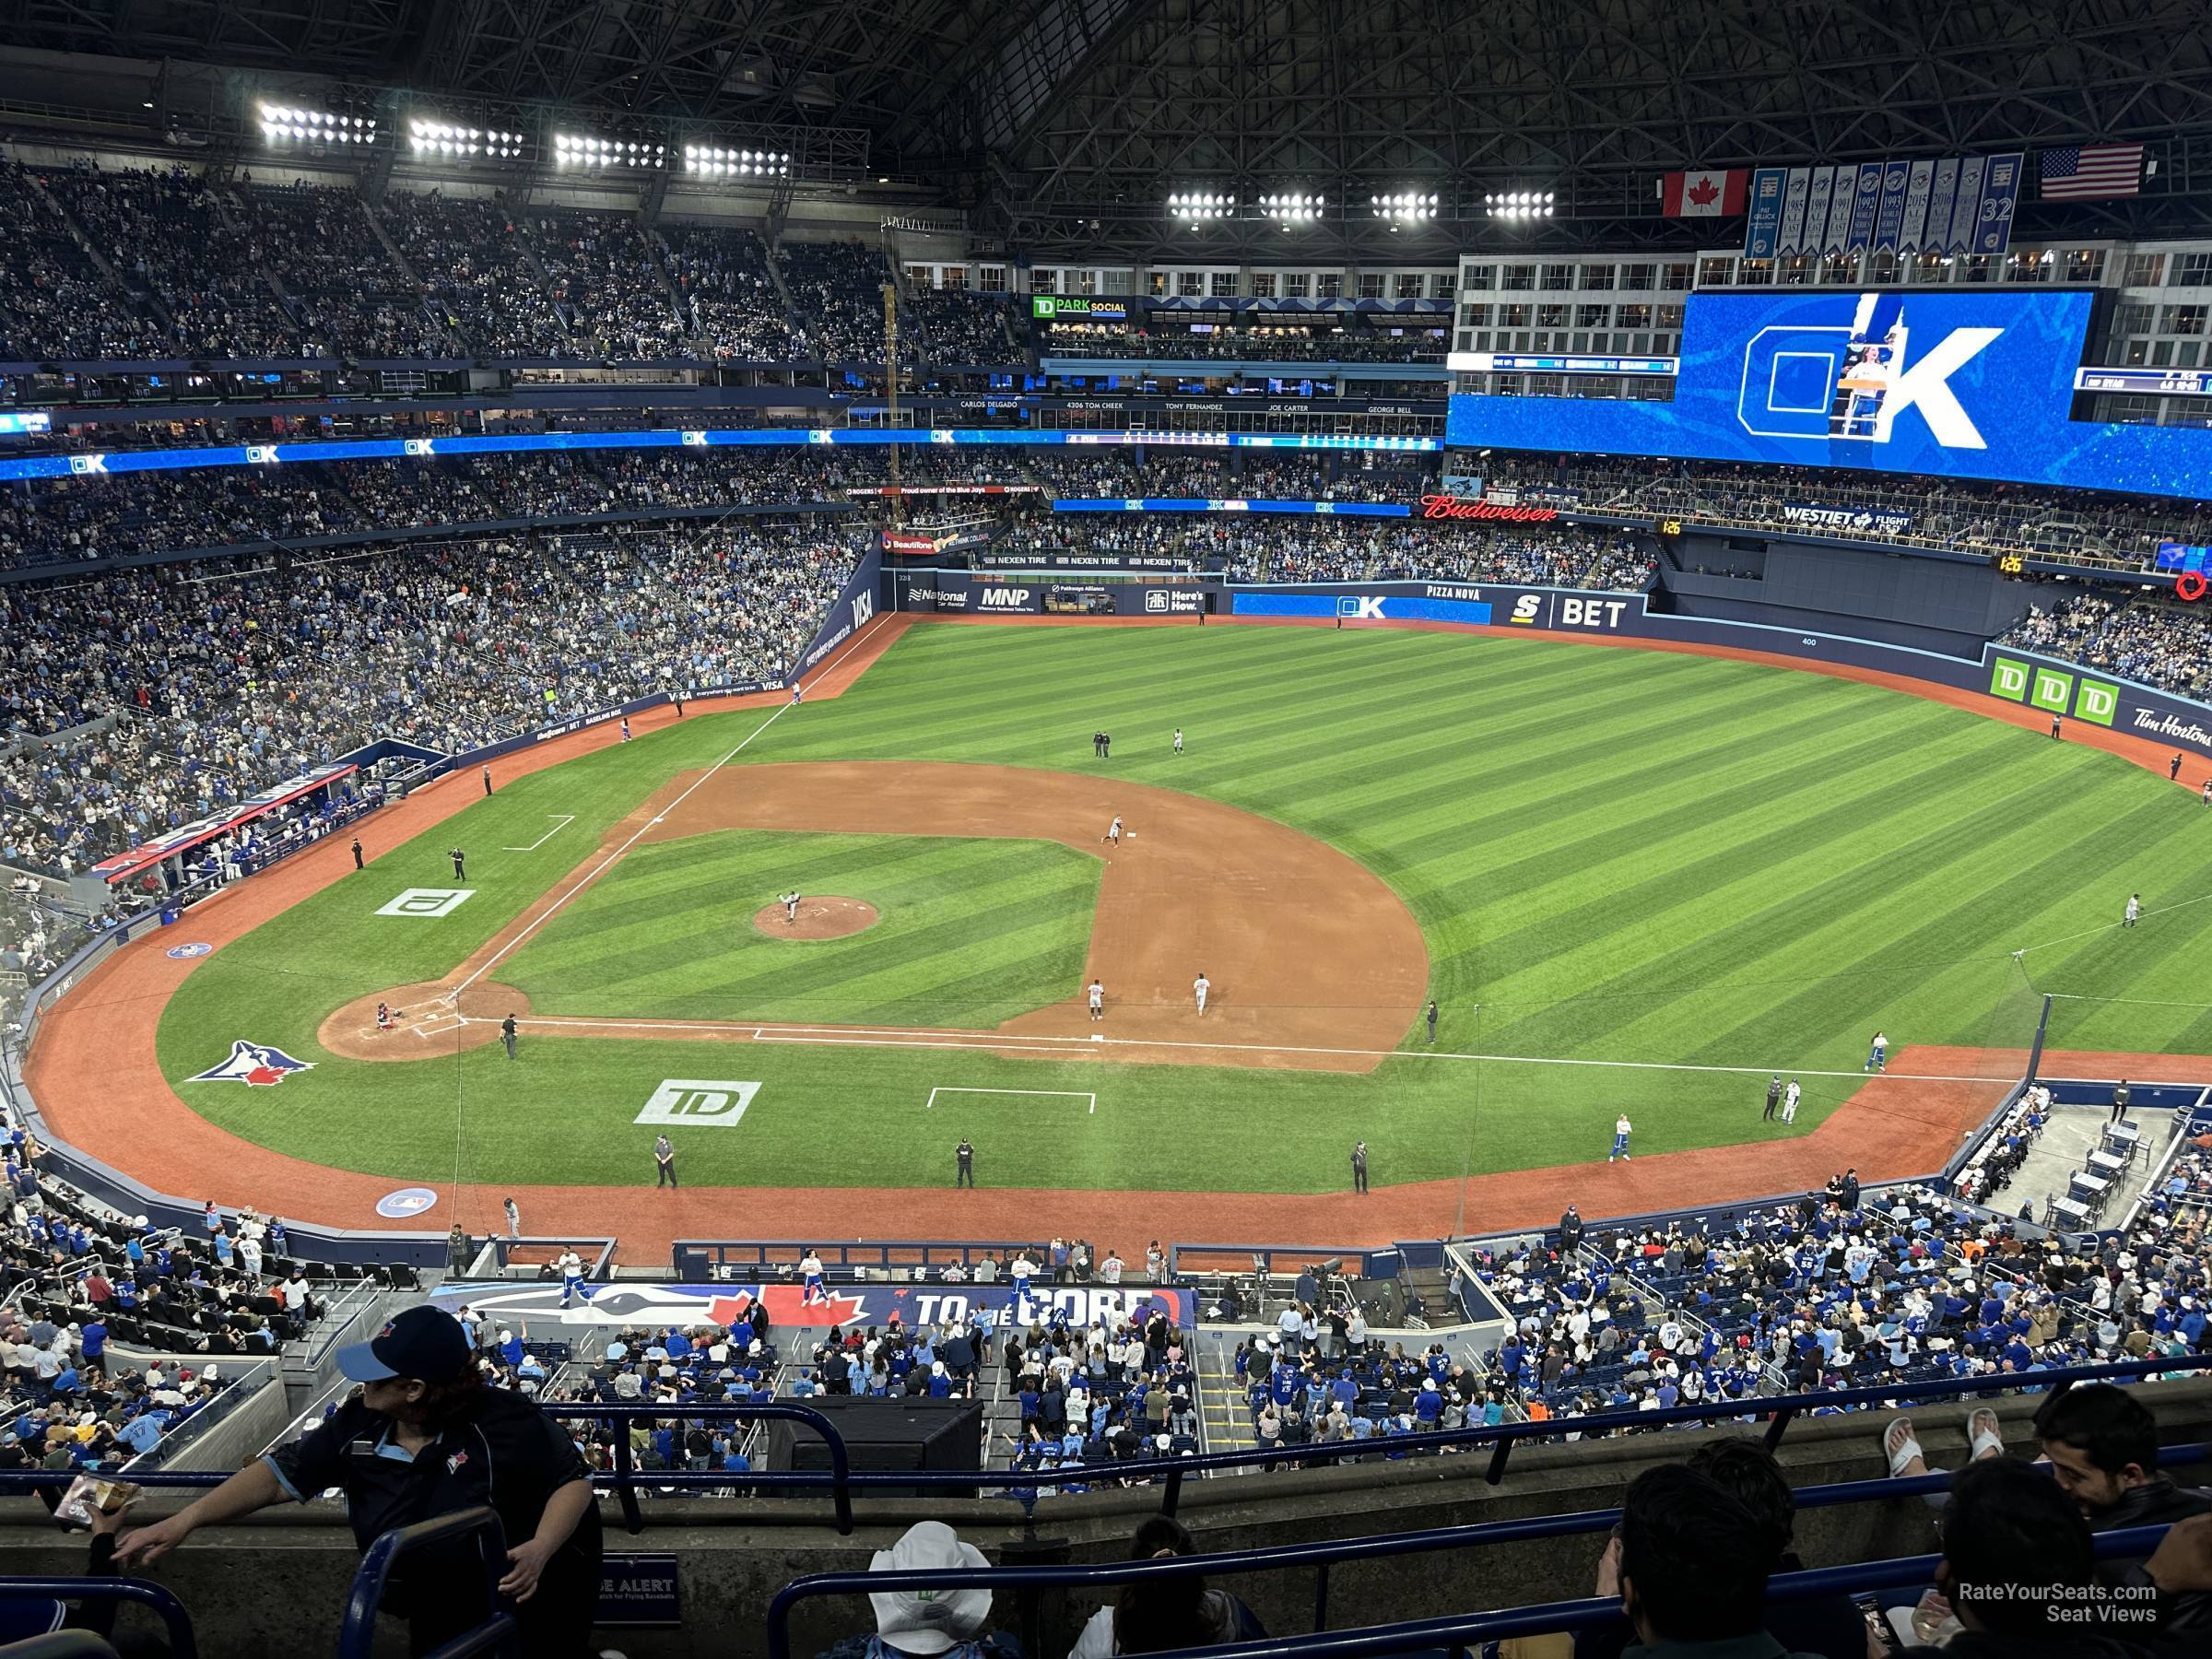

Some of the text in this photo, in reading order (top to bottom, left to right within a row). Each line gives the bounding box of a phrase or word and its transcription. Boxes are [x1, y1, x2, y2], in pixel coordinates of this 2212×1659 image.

[1787, 199, 1804, 212] 1985
[1811, 198, 1827, 210] 1989
[1834, 198, 1850, 209] 1991
[1858, 197, 1875, 209] 1992
[1884, 195, 1901, 208] 1993
[1908, 194, 1926, 206] 2015
[1933, 193, 1951, 206] 2016
[1983, 197, 2012, 221] 32
[1808, 222, 1823, 230] EAST
[1830, 222, 1846, 230] EAST
[1035, 300, 1126, 313] TD PARK SOCIAL
[1185, 403, 1223, 411] FERNANDEZ
[1420, 495, 1558, 522] Budweiser
[1784, 507, 1910, 526] WESTJET FLIGHT
[1663, 521, 1681, 535] 1:26
[893, 540, 932, 549] BeautiTone
[2000, 557, 2021, 572] 1:26
[922, 589, 968, 602] National
[982, 588, 1030, 606] MNP
[1171, 591, 1204, 601] Here's
[1427, 585, 1479, 600] PIZZA NOVA
[851, 588, 873, 629] VISA
[1171, 601, 1197, 611] How.
[1512, 594, 1627, 628] S BET
[1802, 638, 1817, 646] 400
[1998, 665, 2024, 691] TD
[760, 680, 784, 691] VISA
[2039, 676, 2066, 703] TD
[667, 691, 692, 701] VSA
[2083, 687, 2112, 715] TD
[570, 721, 581, 731] BET
[585, 712, 610, 725] BASELINE
[610, 709, 622, 718] BOX
[2134, 708, 2212, 747] Tim Hortons
[397, 892, 458, 912] TD
[63, 976, 73, 991] BET
[668, 1088, 741, 1115] TD
[1740, 1230, 1750, 1240] 10
[1109, 1264, 1118, 1272] 64
[1800, 1260, 1813, 1268] 55
[1596, 1277, 1606, 1285] 27
[915, 1295, 966, 1325] TO
[1667, 1330, 1677, 1339] 19
[1913, 1324, 1925, 1332] 43
[1529, 1347, 1538, 1357] 27
[1841, 1355, 1848, 1363] 6
[133, 1426, 146, 1439] 17
[619, 1579, 674, 1592] ALERT
